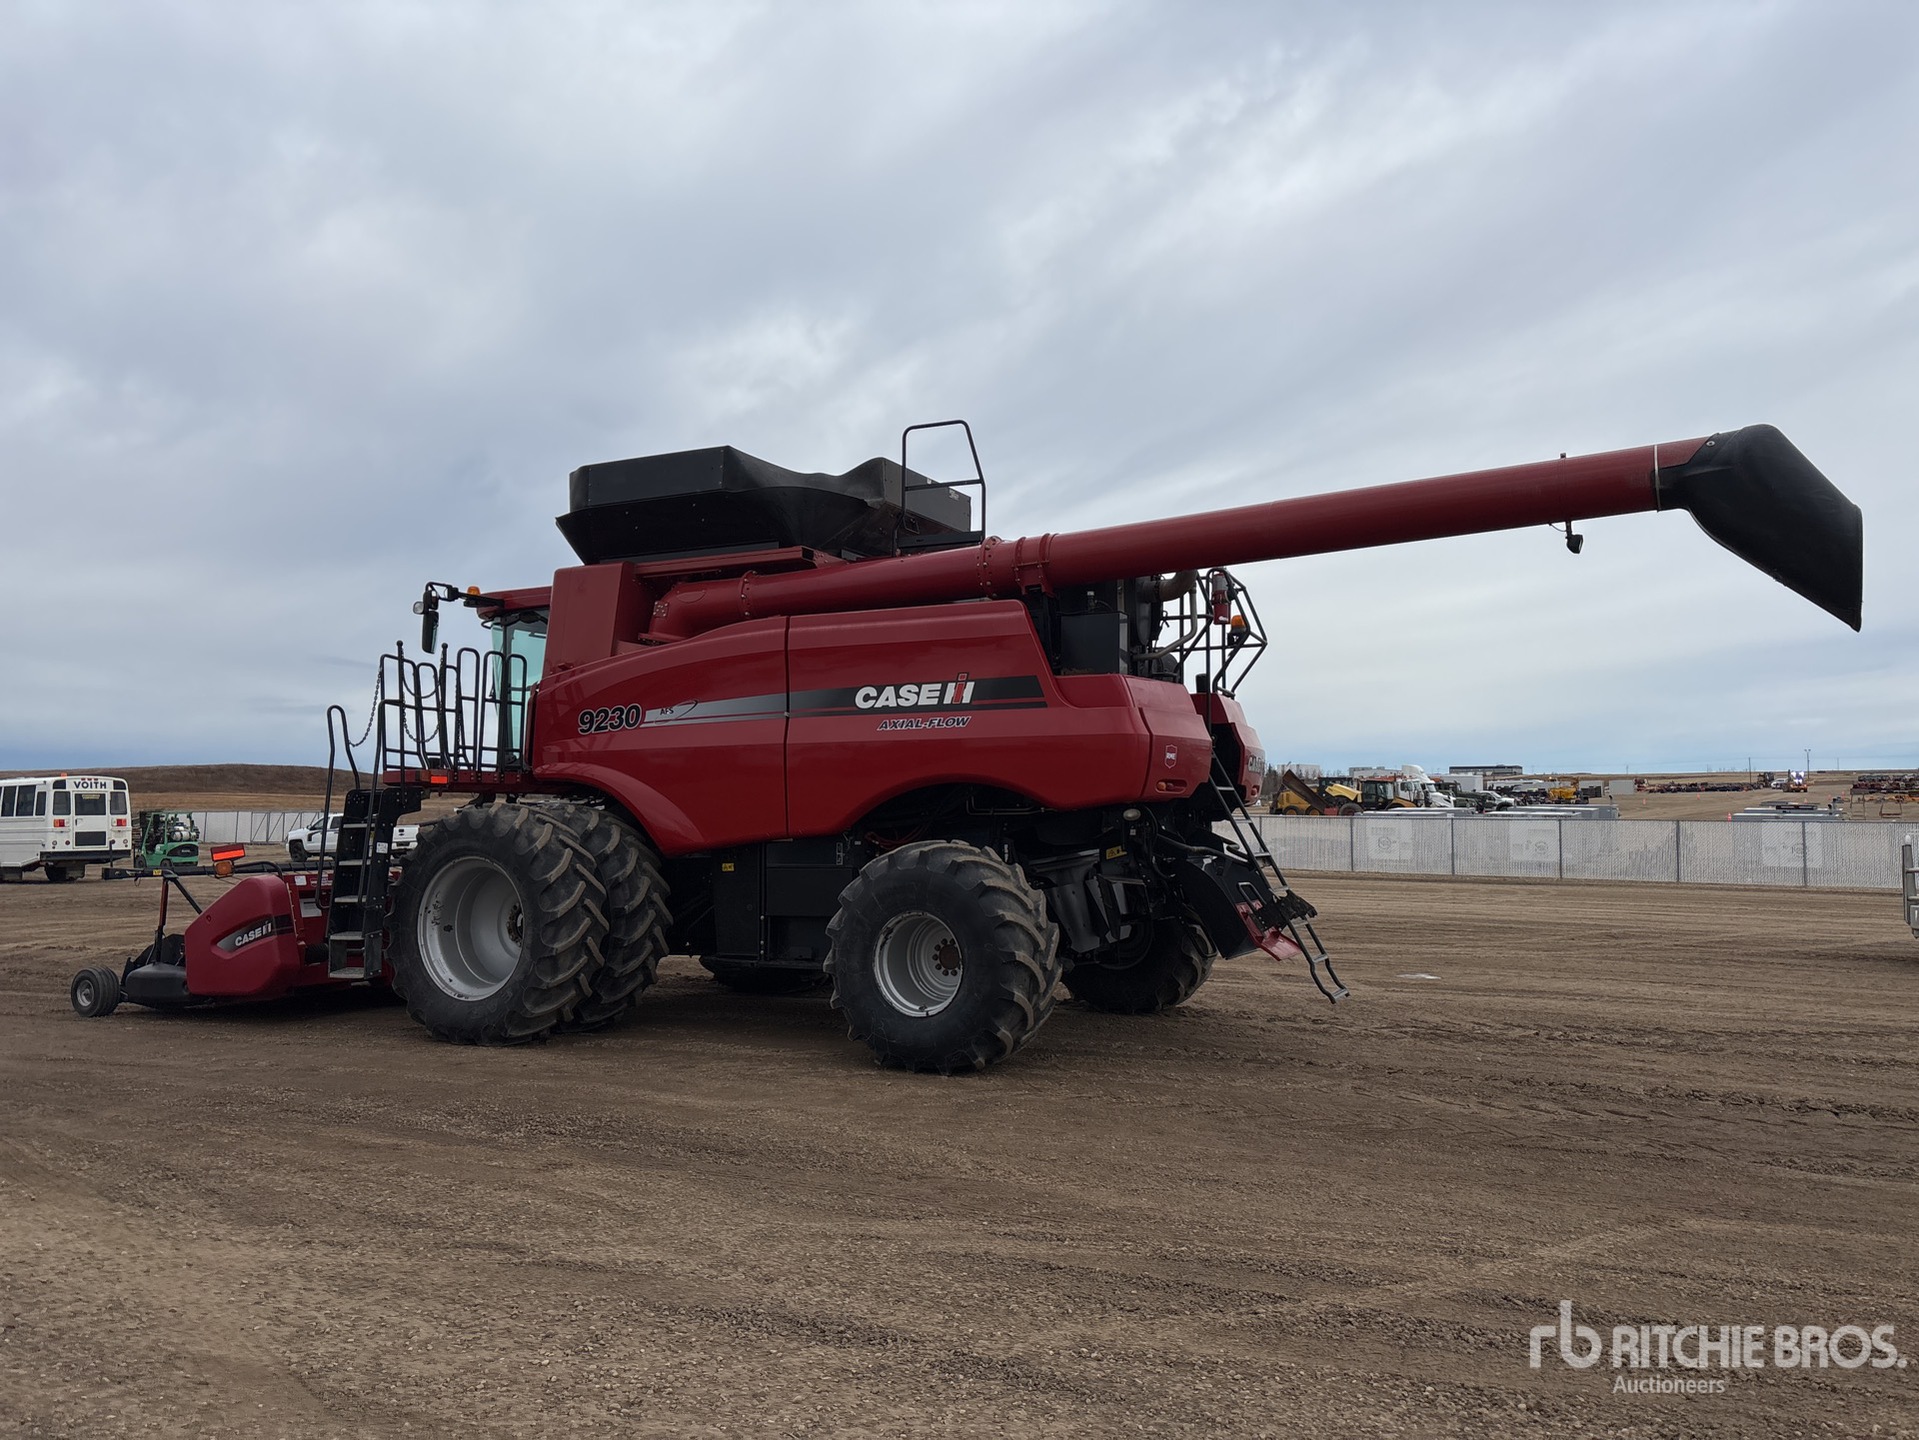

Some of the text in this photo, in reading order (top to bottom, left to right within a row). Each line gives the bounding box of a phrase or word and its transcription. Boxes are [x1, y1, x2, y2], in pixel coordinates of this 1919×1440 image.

[854, 682, 942, 710] CASE
[578, 703, 642, 735] 9230
[877, 715, 972, 731] AXIAL-FLOW
[73, 780, 107, 789] VOITH
[235, 927, 262, 947] CASE
